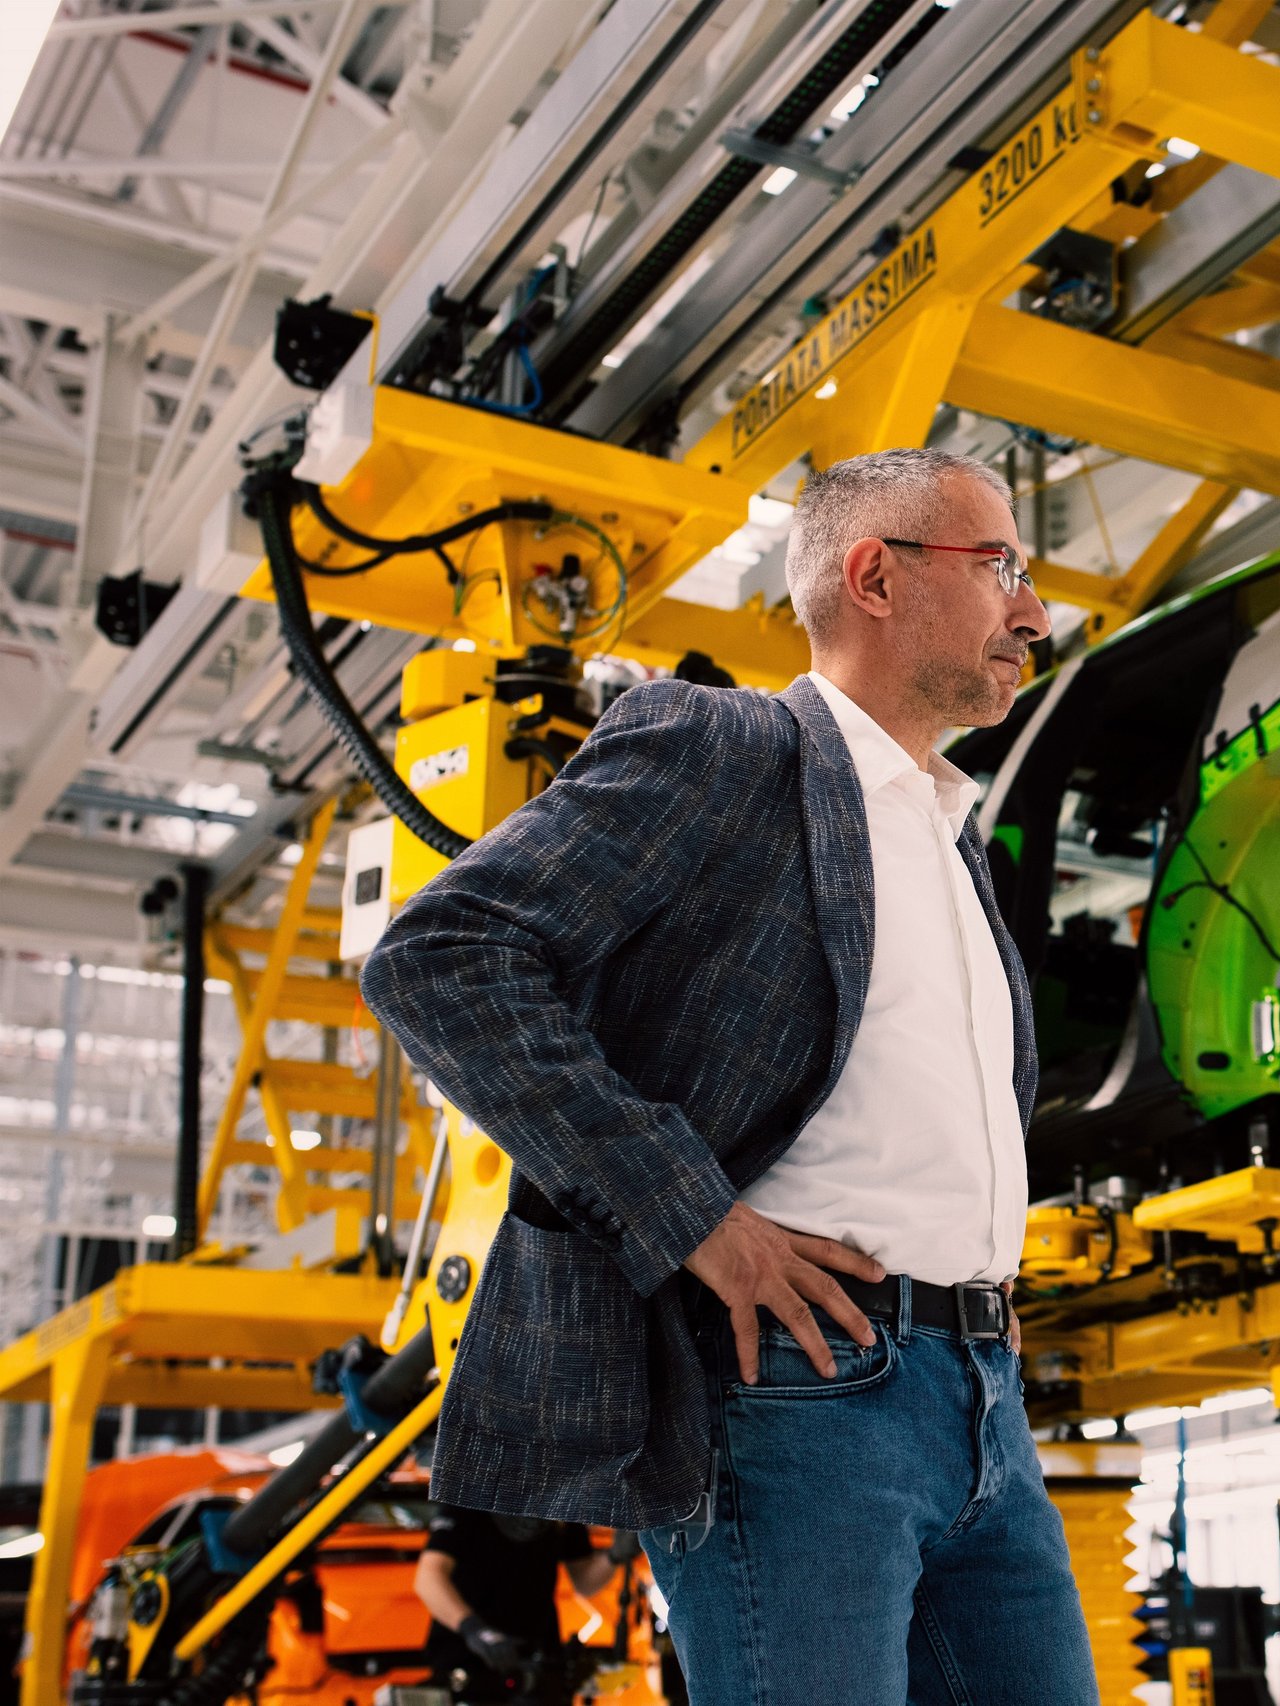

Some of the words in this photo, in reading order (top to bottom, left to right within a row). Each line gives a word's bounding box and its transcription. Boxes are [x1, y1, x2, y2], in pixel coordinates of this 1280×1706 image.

[732, 336, 822, 450] PORTATA
[829, 227, 938, 358] MASSIMA
[979, 123, 1043, 216] 3200
